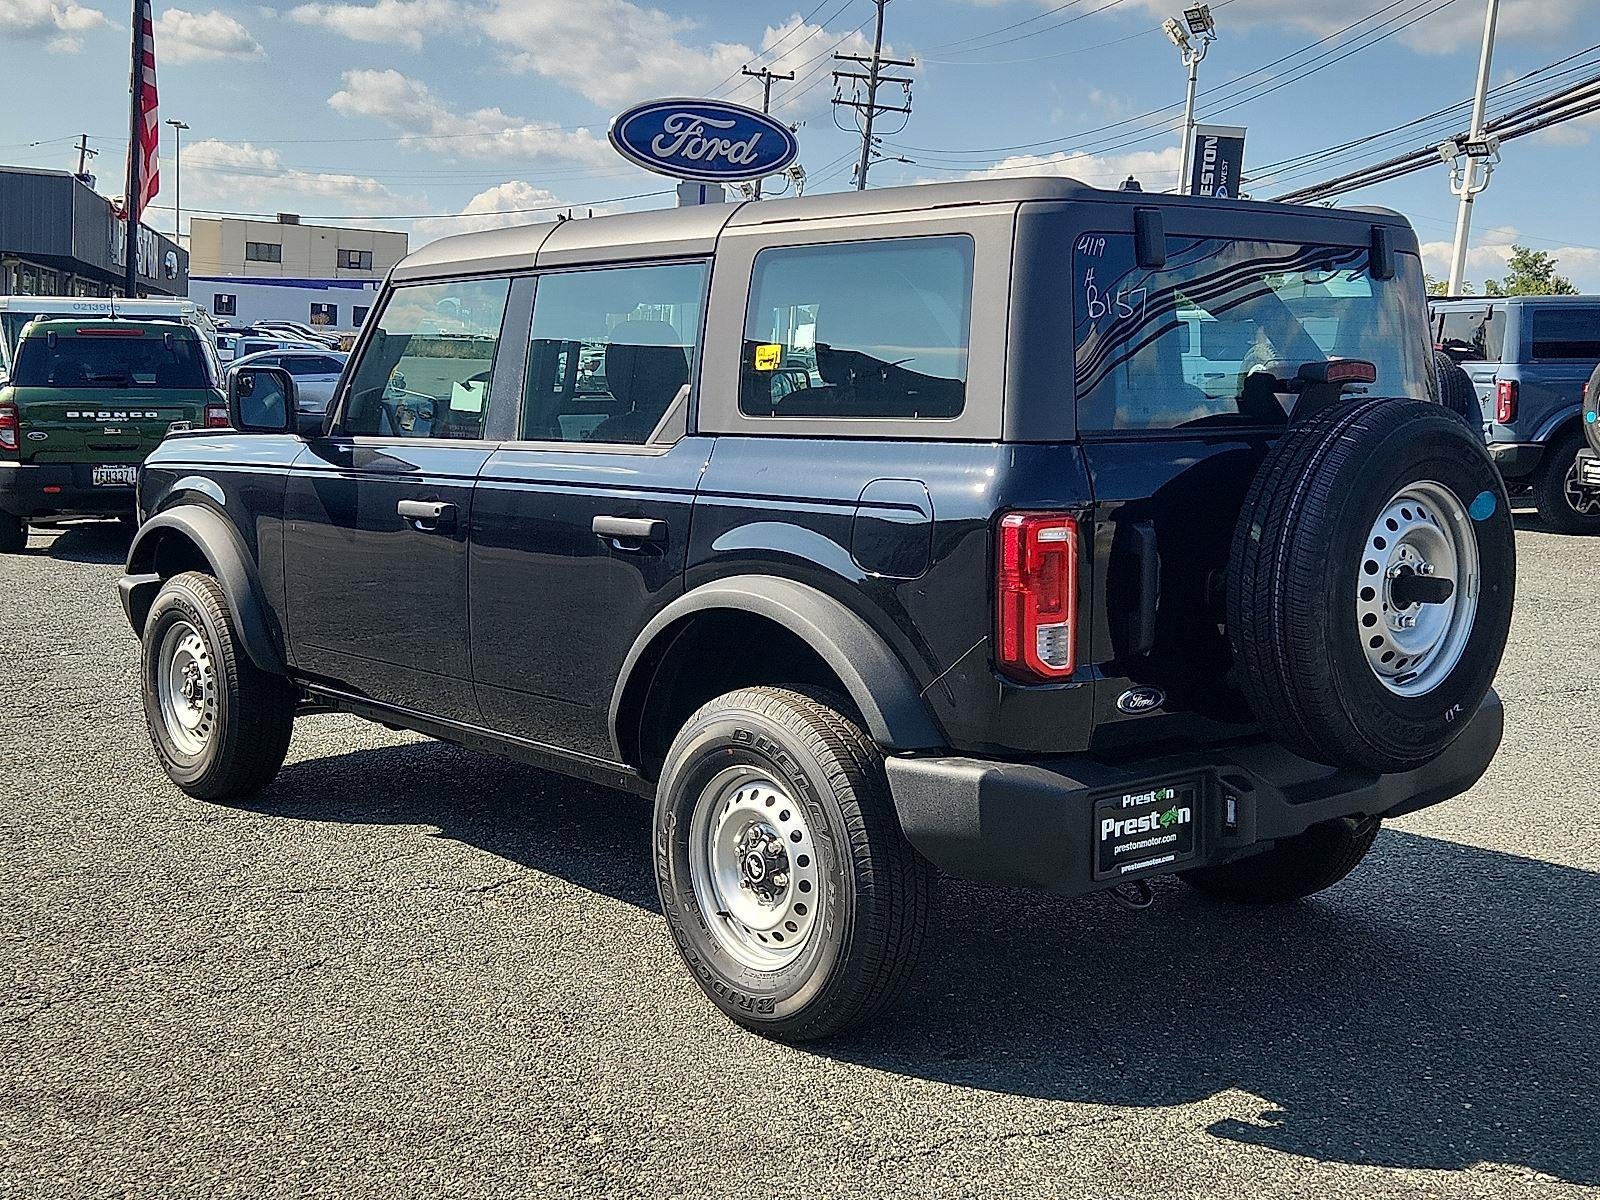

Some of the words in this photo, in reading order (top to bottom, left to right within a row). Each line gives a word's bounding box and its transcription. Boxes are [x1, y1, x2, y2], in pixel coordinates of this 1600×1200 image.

[651, 112, 763, 165] Ford
[1220, 159, 1229, 185] WEST
[117, 217, 160, 280] PSTON
[1077, 236, 1106, 258] 4119
[1086, 284, 1147, 321] B157
[1129, 694, 1155, 708] Ford
[1101, 805, 1191, 840] Preston
[1114, 833, 1177, 856] prestonmotor.com
[1121, 854, 1175, 874] prestonmotor.com
